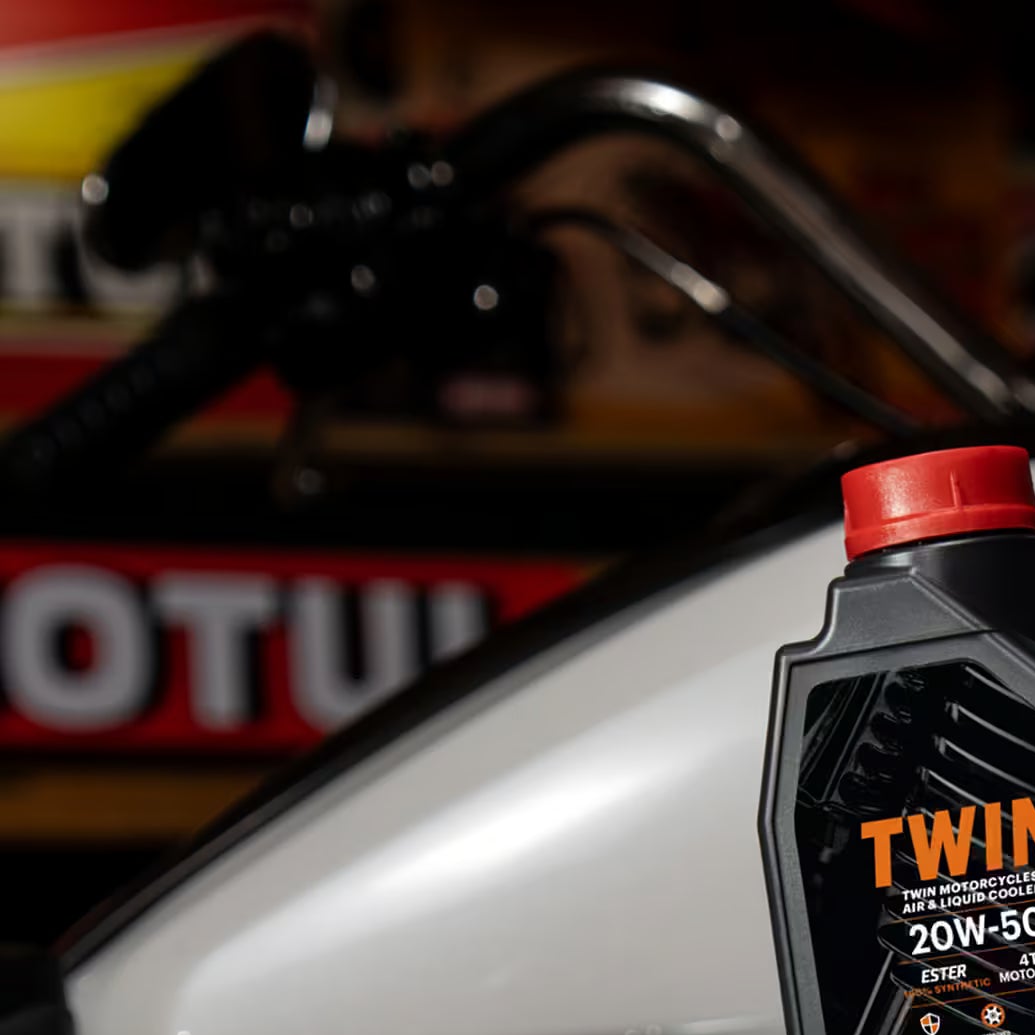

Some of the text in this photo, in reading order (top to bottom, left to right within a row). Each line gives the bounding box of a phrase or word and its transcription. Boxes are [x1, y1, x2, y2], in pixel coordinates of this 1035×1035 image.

[902, 887, 936, 901] TWIN
[902, 902, 925, 914] AIR
[927, 899, 937, 910] &
[940, 892, 986, 909] LIQUID
[921, 964, 967, 984] ESTER
[934, 977, 992, 995] SYNTHETIC
